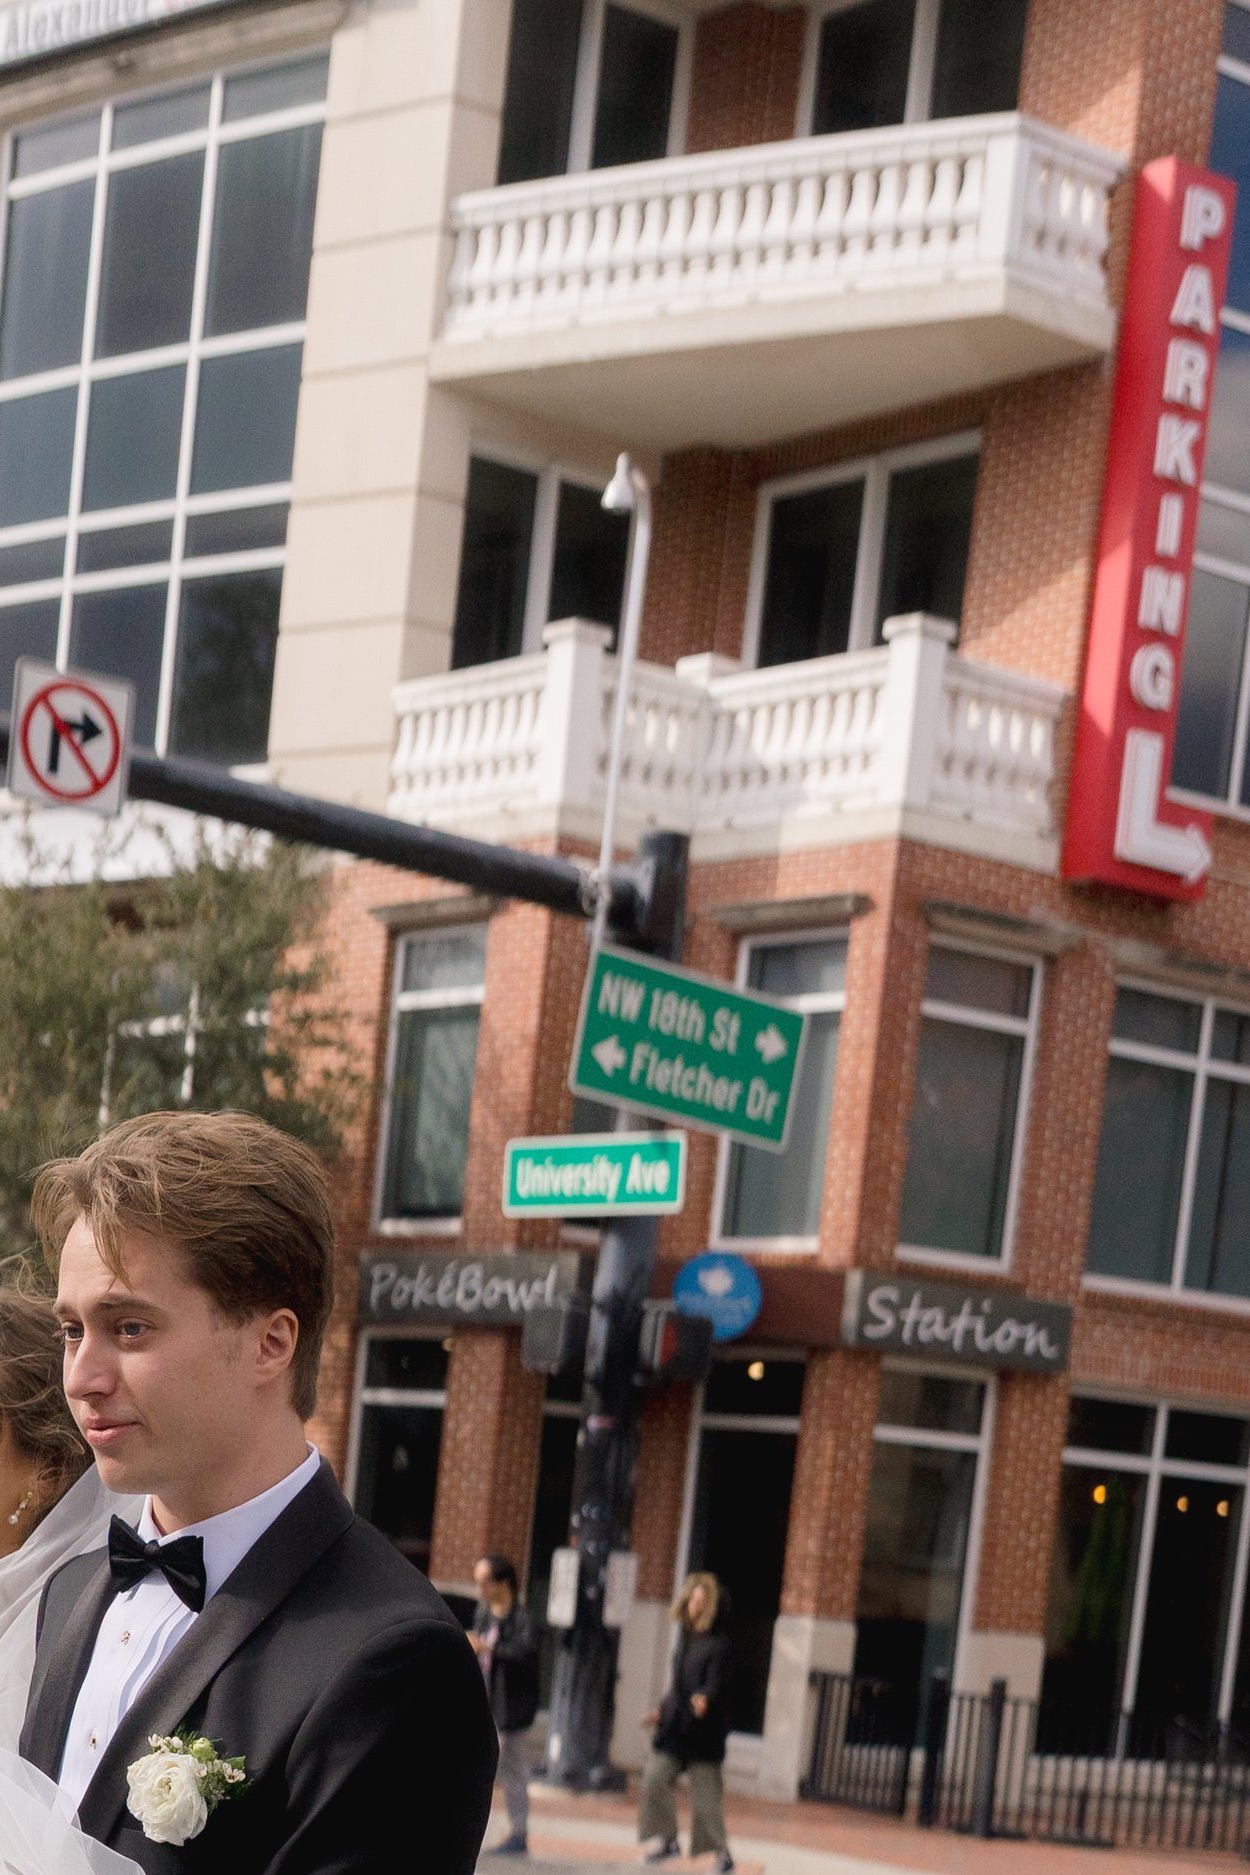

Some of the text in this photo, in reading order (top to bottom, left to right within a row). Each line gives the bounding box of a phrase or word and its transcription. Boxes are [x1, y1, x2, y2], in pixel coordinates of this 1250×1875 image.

[1128, 183, 1226, 712] PARKING
[597, 970, 742, 1056] NW 18th St
[628, 1041, 781, 1125] Fletcher Dr
[516, 1152, 670, 1204] University Ave
[862, 1284, 1060, 1359] Station
